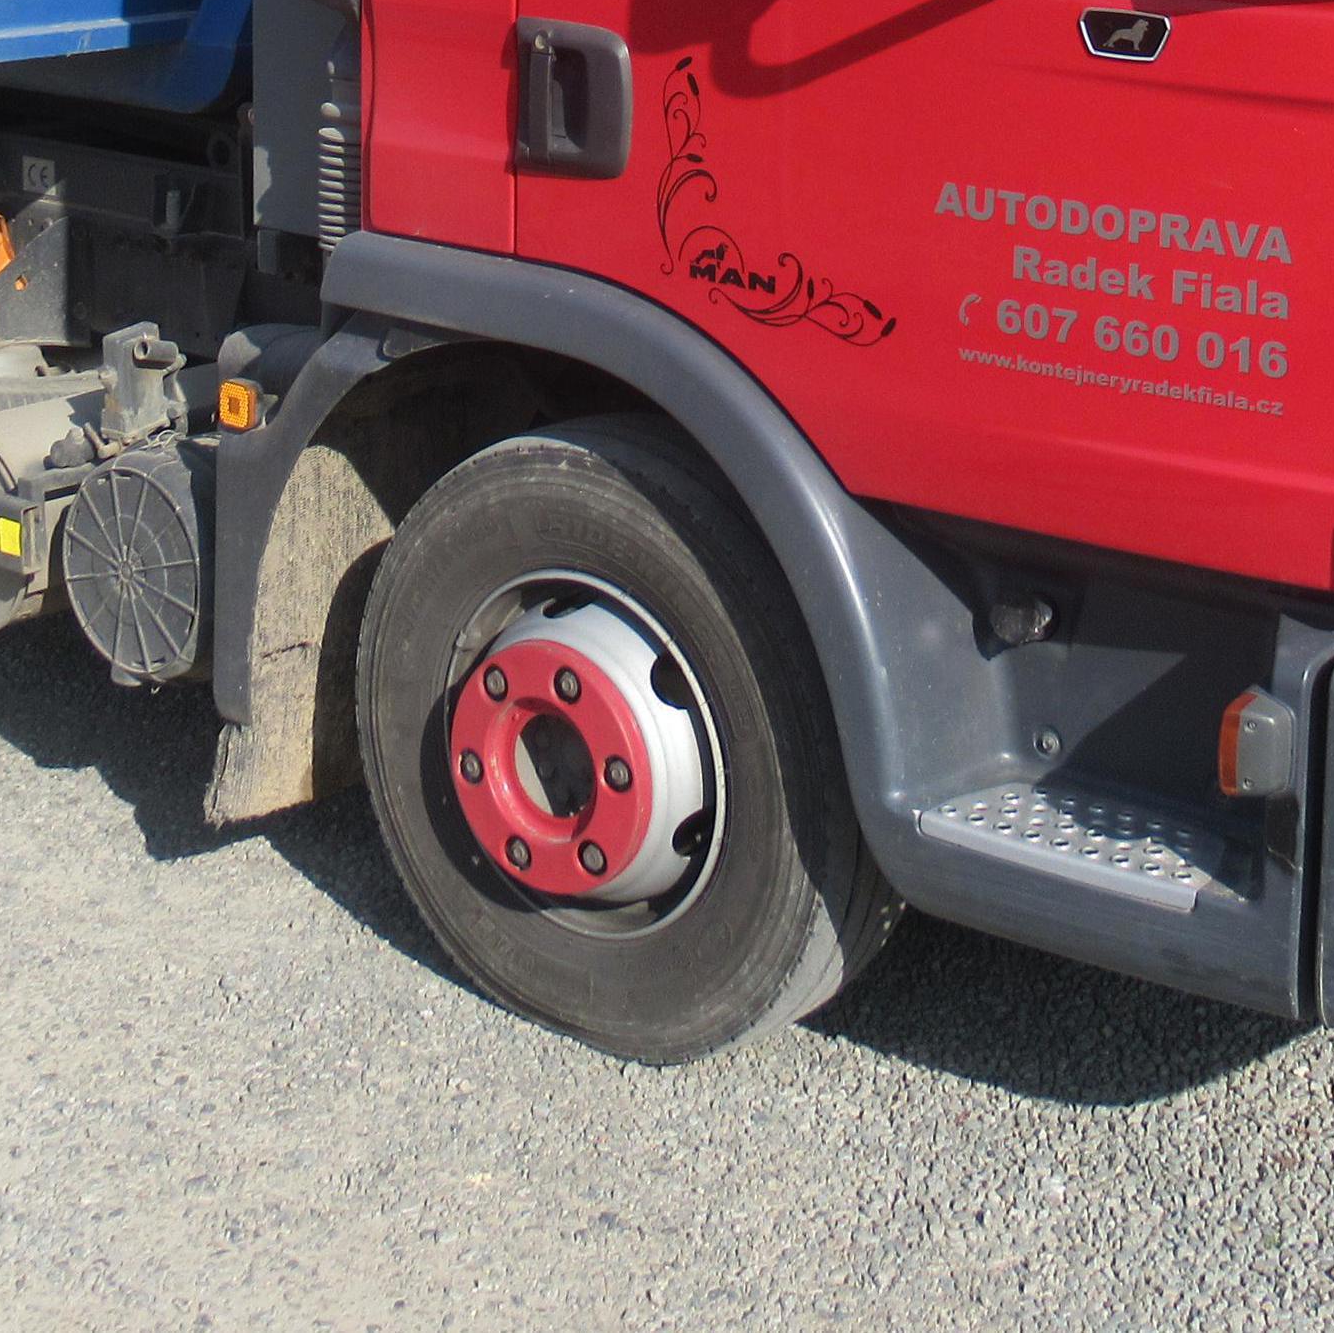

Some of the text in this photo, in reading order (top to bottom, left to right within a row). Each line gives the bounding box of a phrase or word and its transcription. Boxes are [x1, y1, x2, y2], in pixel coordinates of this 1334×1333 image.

[934, 182, 1292, 264] AUTODOPRAVA
[690, 264, 776, 294] MAN
[1012, 245, 1290, 320] Radek Fiala
[997, 299, 1289, 379] 607 660 016
[959, 347, 1284, 416] www.kontejneryradekfiala.cz
